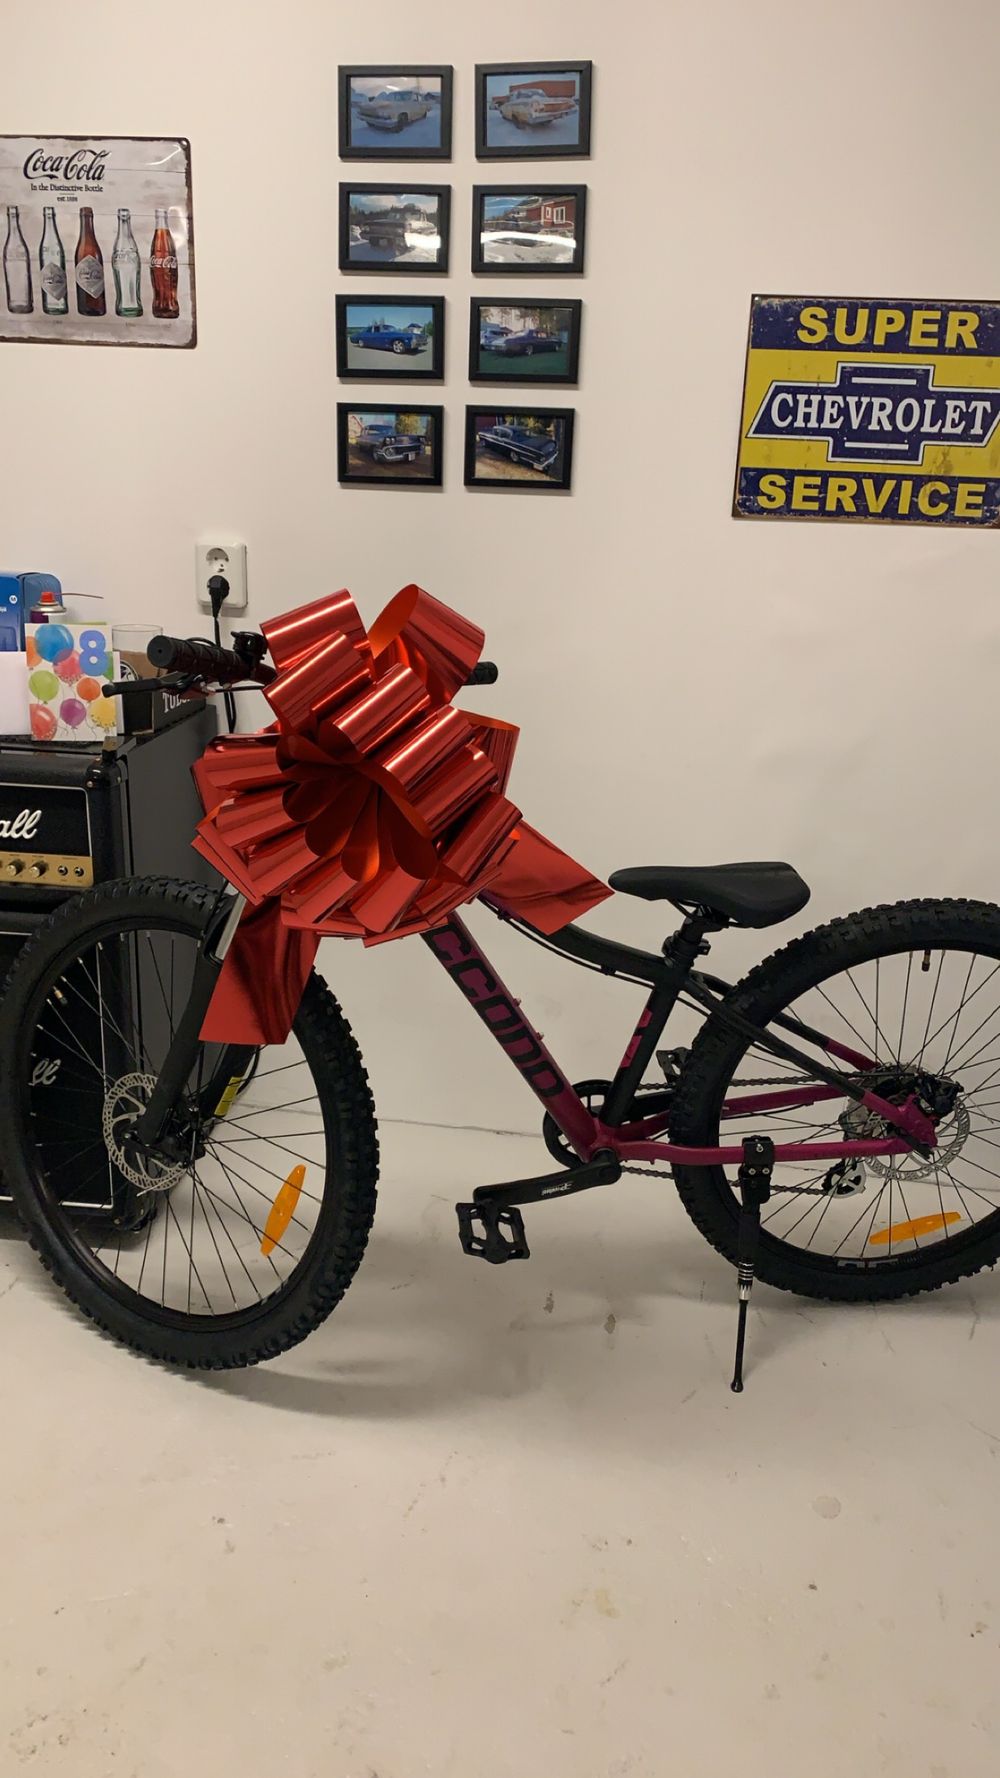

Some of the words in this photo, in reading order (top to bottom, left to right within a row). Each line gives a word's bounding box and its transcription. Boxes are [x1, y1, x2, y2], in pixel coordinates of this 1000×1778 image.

[30, 183, 37, 191] In
[39, 183, 49, 191] the
[50, 183, 83, 192] Distinctive
[84, 184, 104, 192] Bottle
[797, 306, 980, 349] SUPER
[771, 392, 992, 435] CHEVROLET
[756, 474, 987, 518] SERVICE
[79, 630, 108, 677] 8
